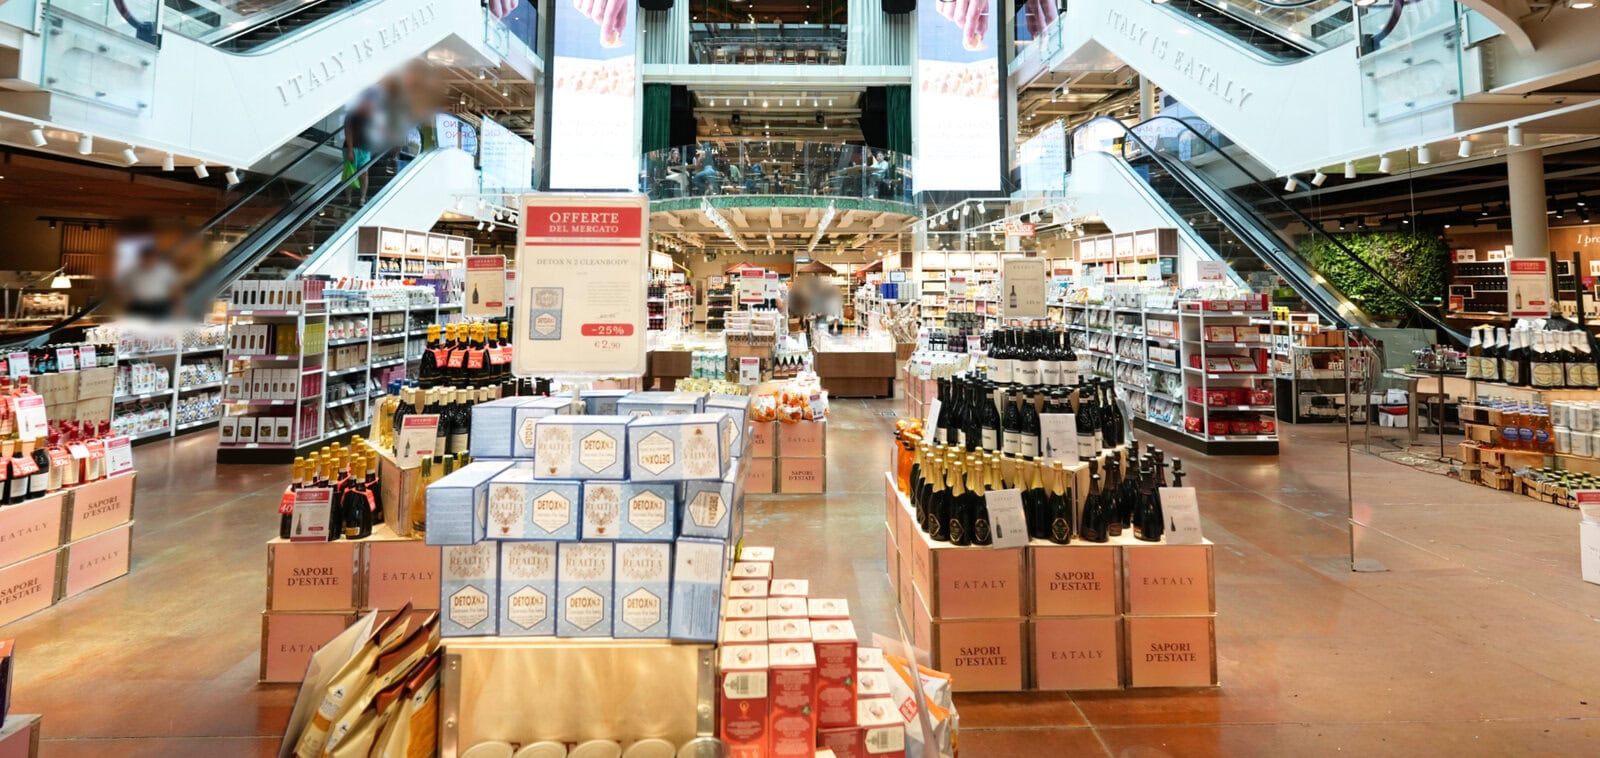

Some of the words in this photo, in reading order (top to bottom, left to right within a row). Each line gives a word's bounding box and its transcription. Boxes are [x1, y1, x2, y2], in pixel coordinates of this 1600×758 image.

[275, 51, 346, 107] ITALY
[353, 39, 374, 62] IS
[379, 2, 441, 49] EATALY
[1106, 9, 1148, 46] ITALY
[1150, 36, 1168, 60] IS
[1174, 50, 1254, 110] EATALY
[549, 211, 620, 224] OFFERTE
[549, 225, 569, 233] DEL
[571, 225, 619, 233] MERCATO
[592, 326, 625, 335] -25%
[88, 495, 118, 510] SAPORI
[83, 502, 121, 519] D'ESTATE
[0, 522, 48, 542] EATALY
[80, 550, 120, 570] EATALY
[293, 567, 334, 577] SAPORI
[382, 572, 434, 581] EATALY
[1054, 571, 1095, 581] SAPORI
[287, 577, 339, 587] D'ESTATE
[953, 580, 1006, 589] EATALY
[1050, 581, 1101, 592] D'ESTATE
[1143, 576, 1194, 586] EATALY
[0, 577, 38, 598] SAPORI
[0, 584, 42, 605] 'ESTATE
[960, 646, 1001, 656] SAPORI
[1150, 643, 1191, 652] SAPORI
[1051, 650, 1103, 660] EATALY
[1145, 652, 1196, 663] D'ESTATE
[955, 656, 1007, 667] D'ESTATE
